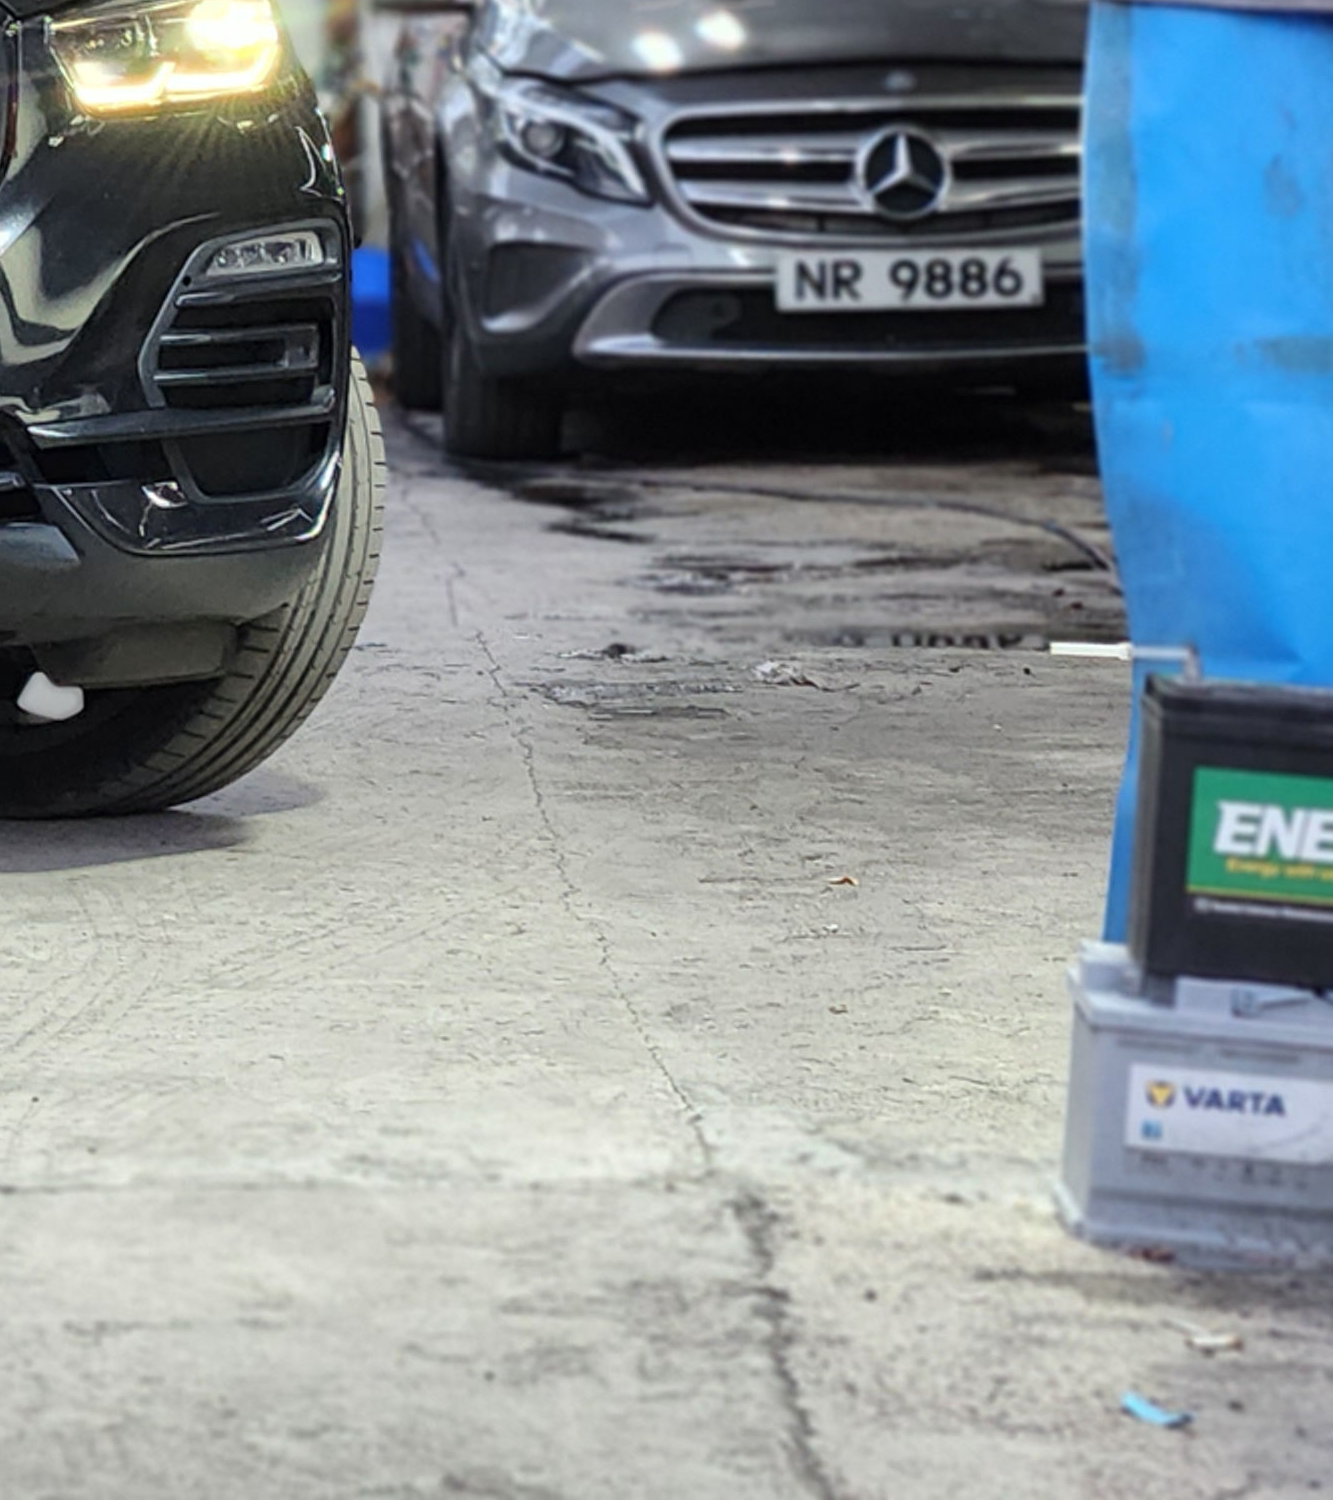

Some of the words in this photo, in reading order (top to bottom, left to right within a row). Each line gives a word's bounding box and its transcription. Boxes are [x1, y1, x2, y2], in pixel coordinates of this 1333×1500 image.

[795, 260, 863, 301] NR
[888, 256, 1024, 301] 9886
[1183, 1085, 1286, 1117] VARTA
